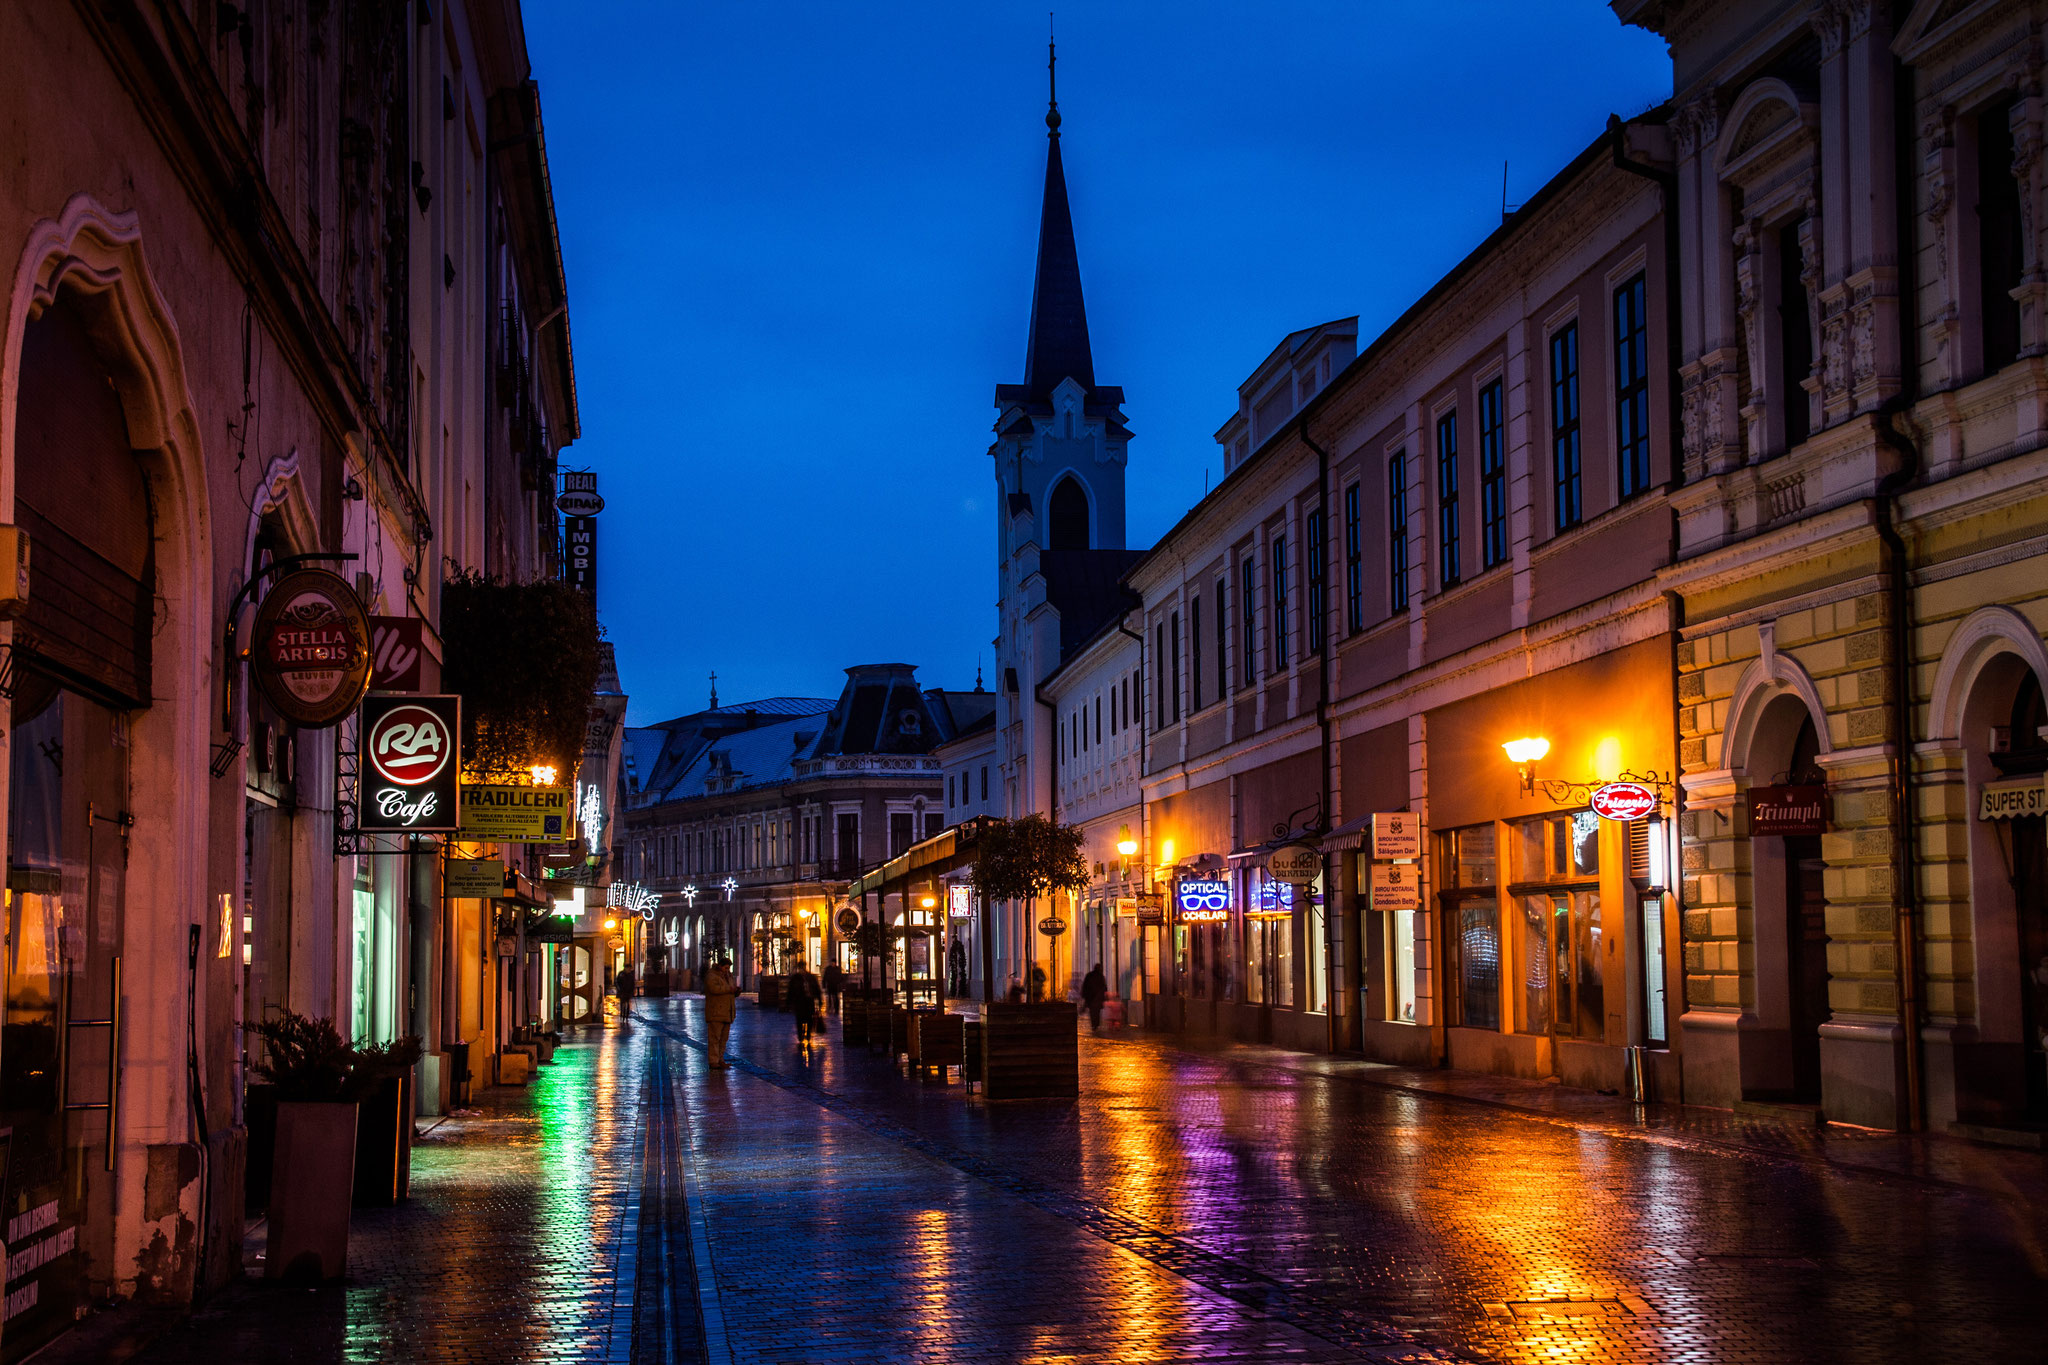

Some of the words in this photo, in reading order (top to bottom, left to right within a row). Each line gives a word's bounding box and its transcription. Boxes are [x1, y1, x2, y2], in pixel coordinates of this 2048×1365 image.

[567, 475, 595, 490] REAL
[277, 631, 347, 646] STELLA
[277, 646, 349, 662] ARTOIS
[292, 671, 334, 680] LEUVEN
[379, 722, 442, 755] RA
[376, 787, 438, 826] Café
[460, 790, 564, 808] TRADUCERI
[1595, 794, 1652, 808] Frizerie
[1985, 791, 2025, 812] SUPER
[2028, 788, 2045, 808] ST
[1755, 801, 1821, 823] Triumph
[1181, 883, 1227, 894] OPTICAL
[1182, 911, 1228, 920] OCHELARI
